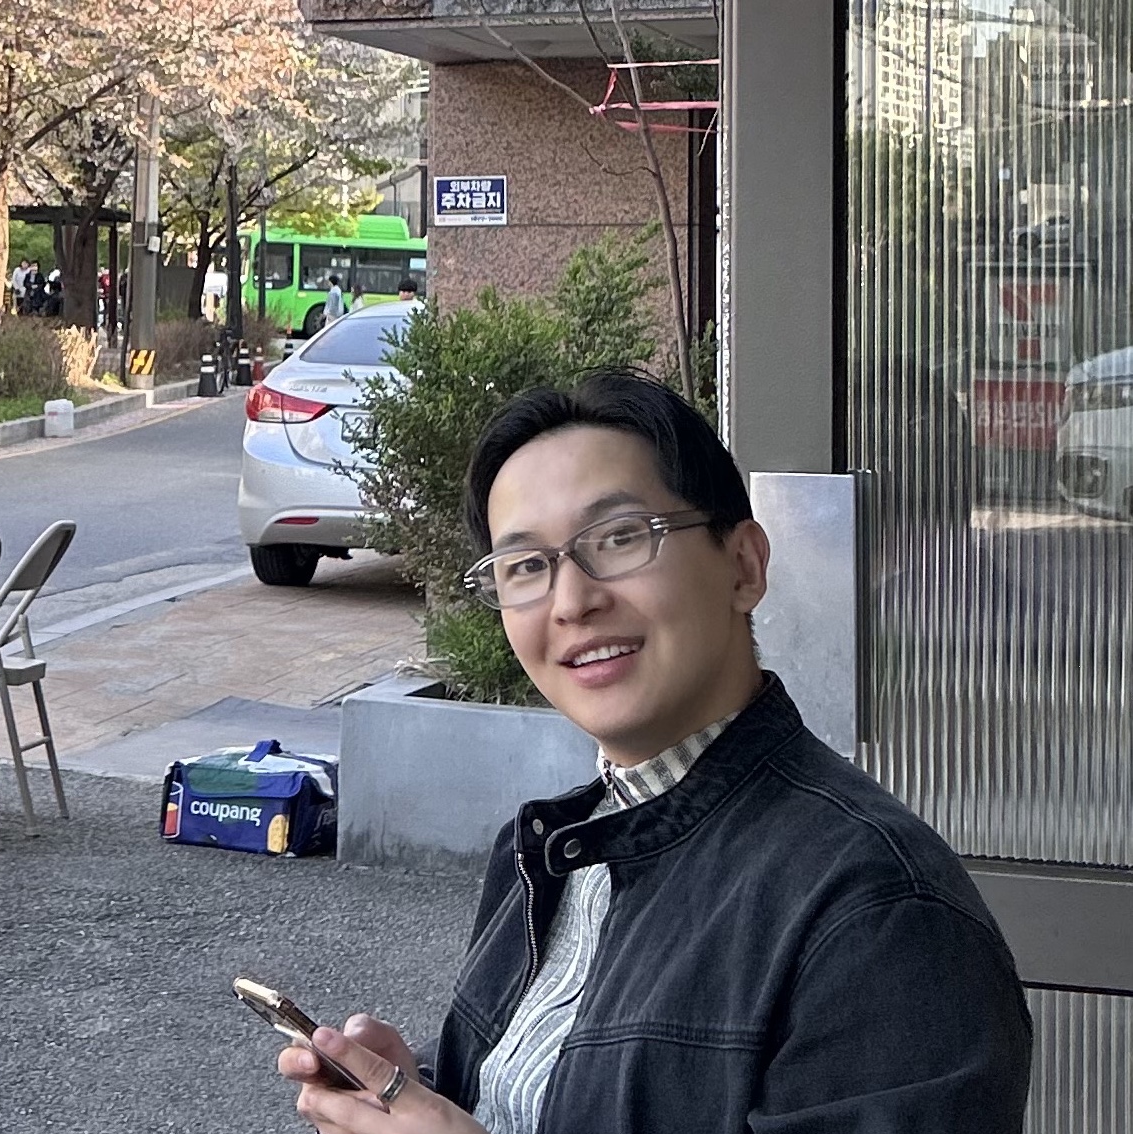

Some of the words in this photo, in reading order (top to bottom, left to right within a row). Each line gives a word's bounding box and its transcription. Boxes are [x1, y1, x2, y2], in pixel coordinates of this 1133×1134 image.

[449, 180, 492, 193] 외부차량
[441, 191, 501, 209] 주차금지
[190, 801, 262, 827] coupang
